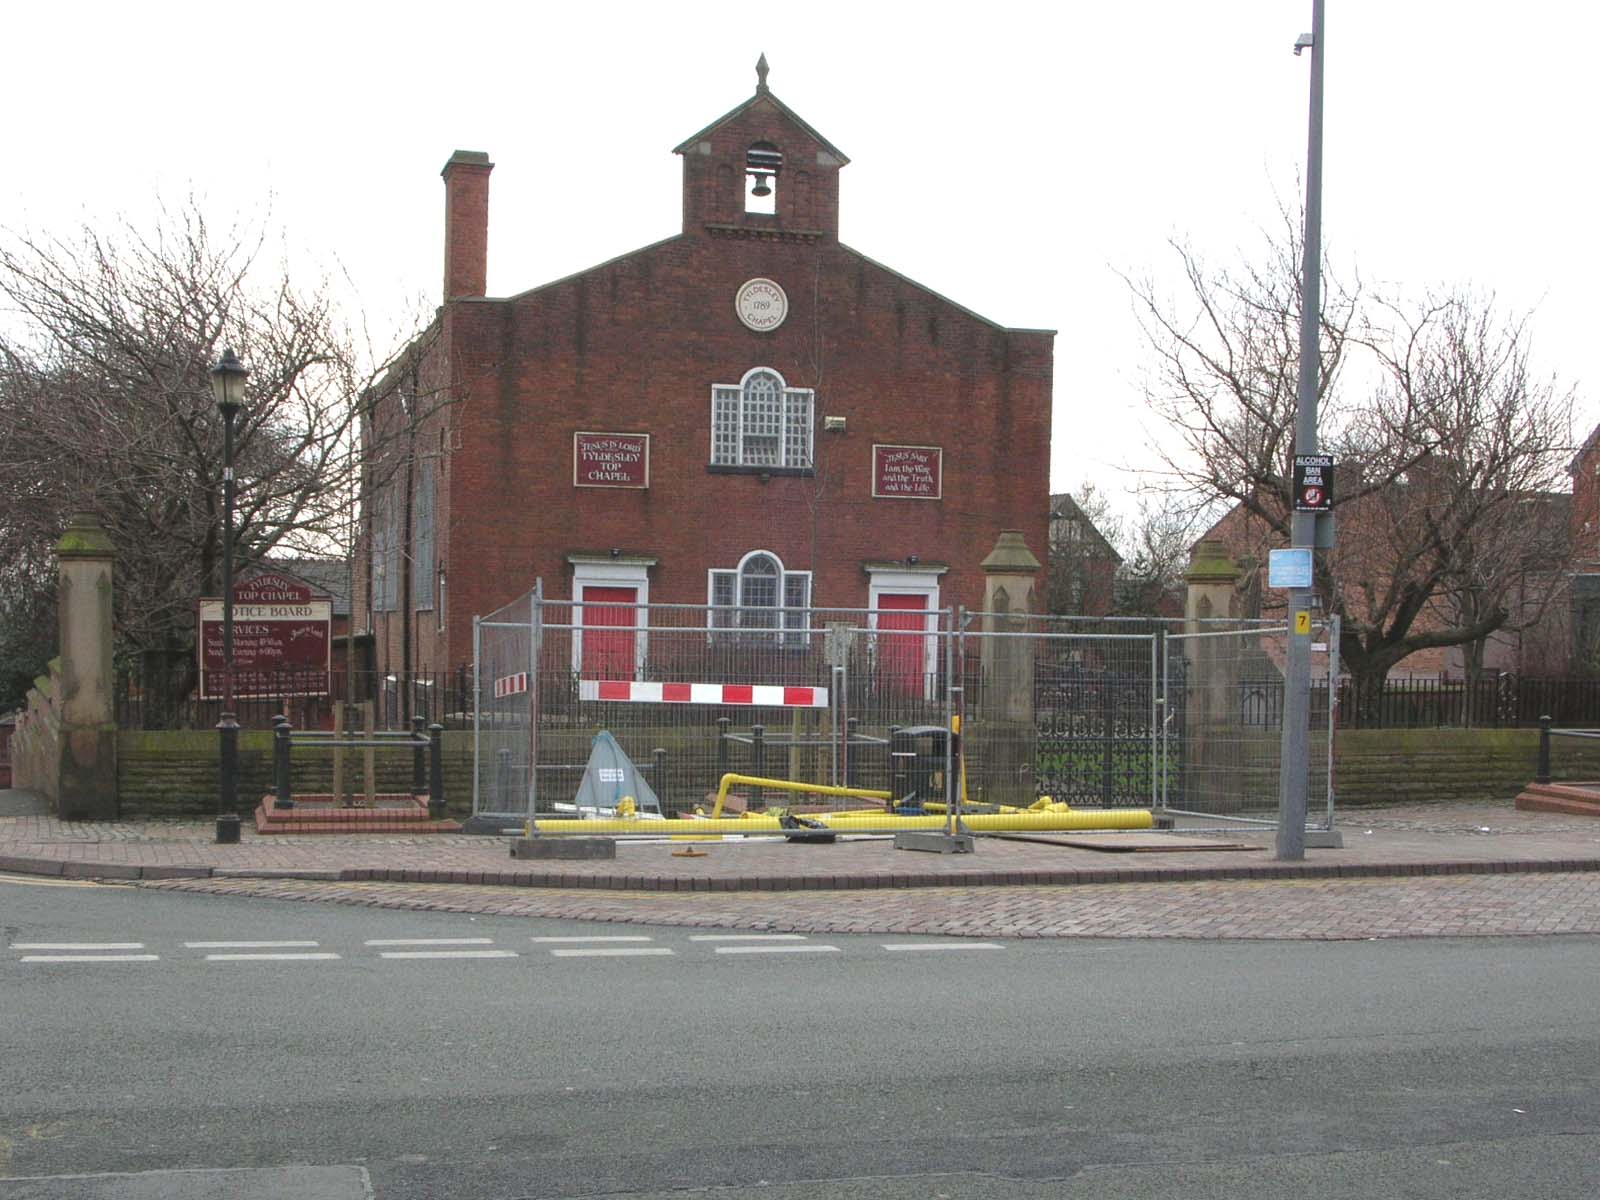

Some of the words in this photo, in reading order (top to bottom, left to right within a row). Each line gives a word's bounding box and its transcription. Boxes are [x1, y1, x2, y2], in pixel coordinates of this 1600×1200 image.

[744, 286, 780, 302] TYLDESLEY
[753, 301, 770, 310] 1789
[747, 313, 776, 325] CHAPEL
[618, 442, 641, 452] LORD
[583, 452, 641, 462] TYLDESLEY
[1296, 456, 1331, 466] ALCOHOL
[600, 462, 622, 471] TOP
[902, 464, 914, 473] the
[914, 464, 931, 475] Way
[1305, 466, 1321, 476] BAN
[588, 471, 631, 481] CHAPEL
[898, 474, 910, 482] the
[911, 473, 934, 484] Truth
[1302, 476, 1324, 486] AREA
[239, 592, 258, 601] TOP
[261, 591, 303, 601] CHAPEL
[222, 606, 268, 617] OTICE
[270, 606, 313, 617] BOARD
[1298, 615, 1306, 627] 7
[218, 625, 270, 635] SRVICES
